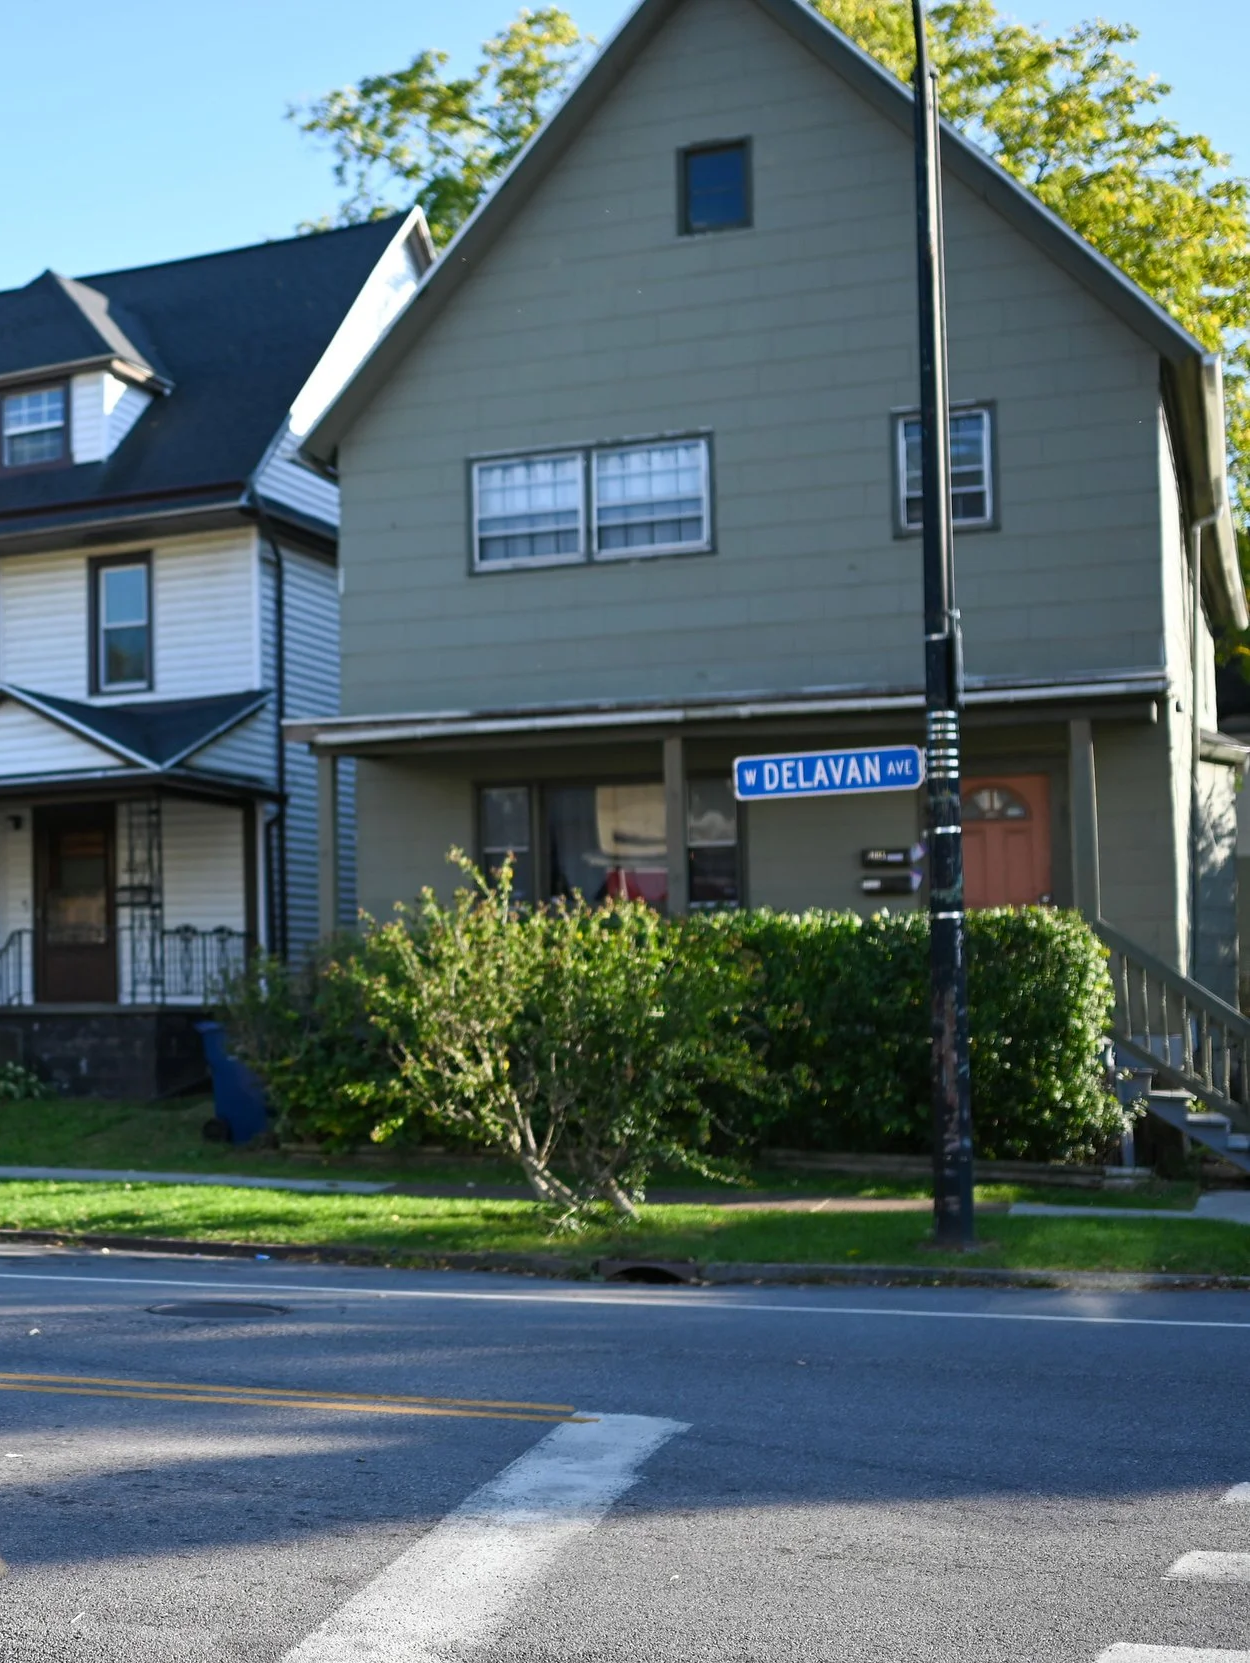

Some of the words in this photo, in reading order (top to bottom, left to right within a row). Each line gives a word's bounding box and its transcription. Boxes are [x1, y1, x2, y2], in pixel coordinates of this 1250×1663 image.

[743, 768, 757, 787] W
[763, 754, 881, 791] DELAVAN
[887, 758, 913, 776] AVE
